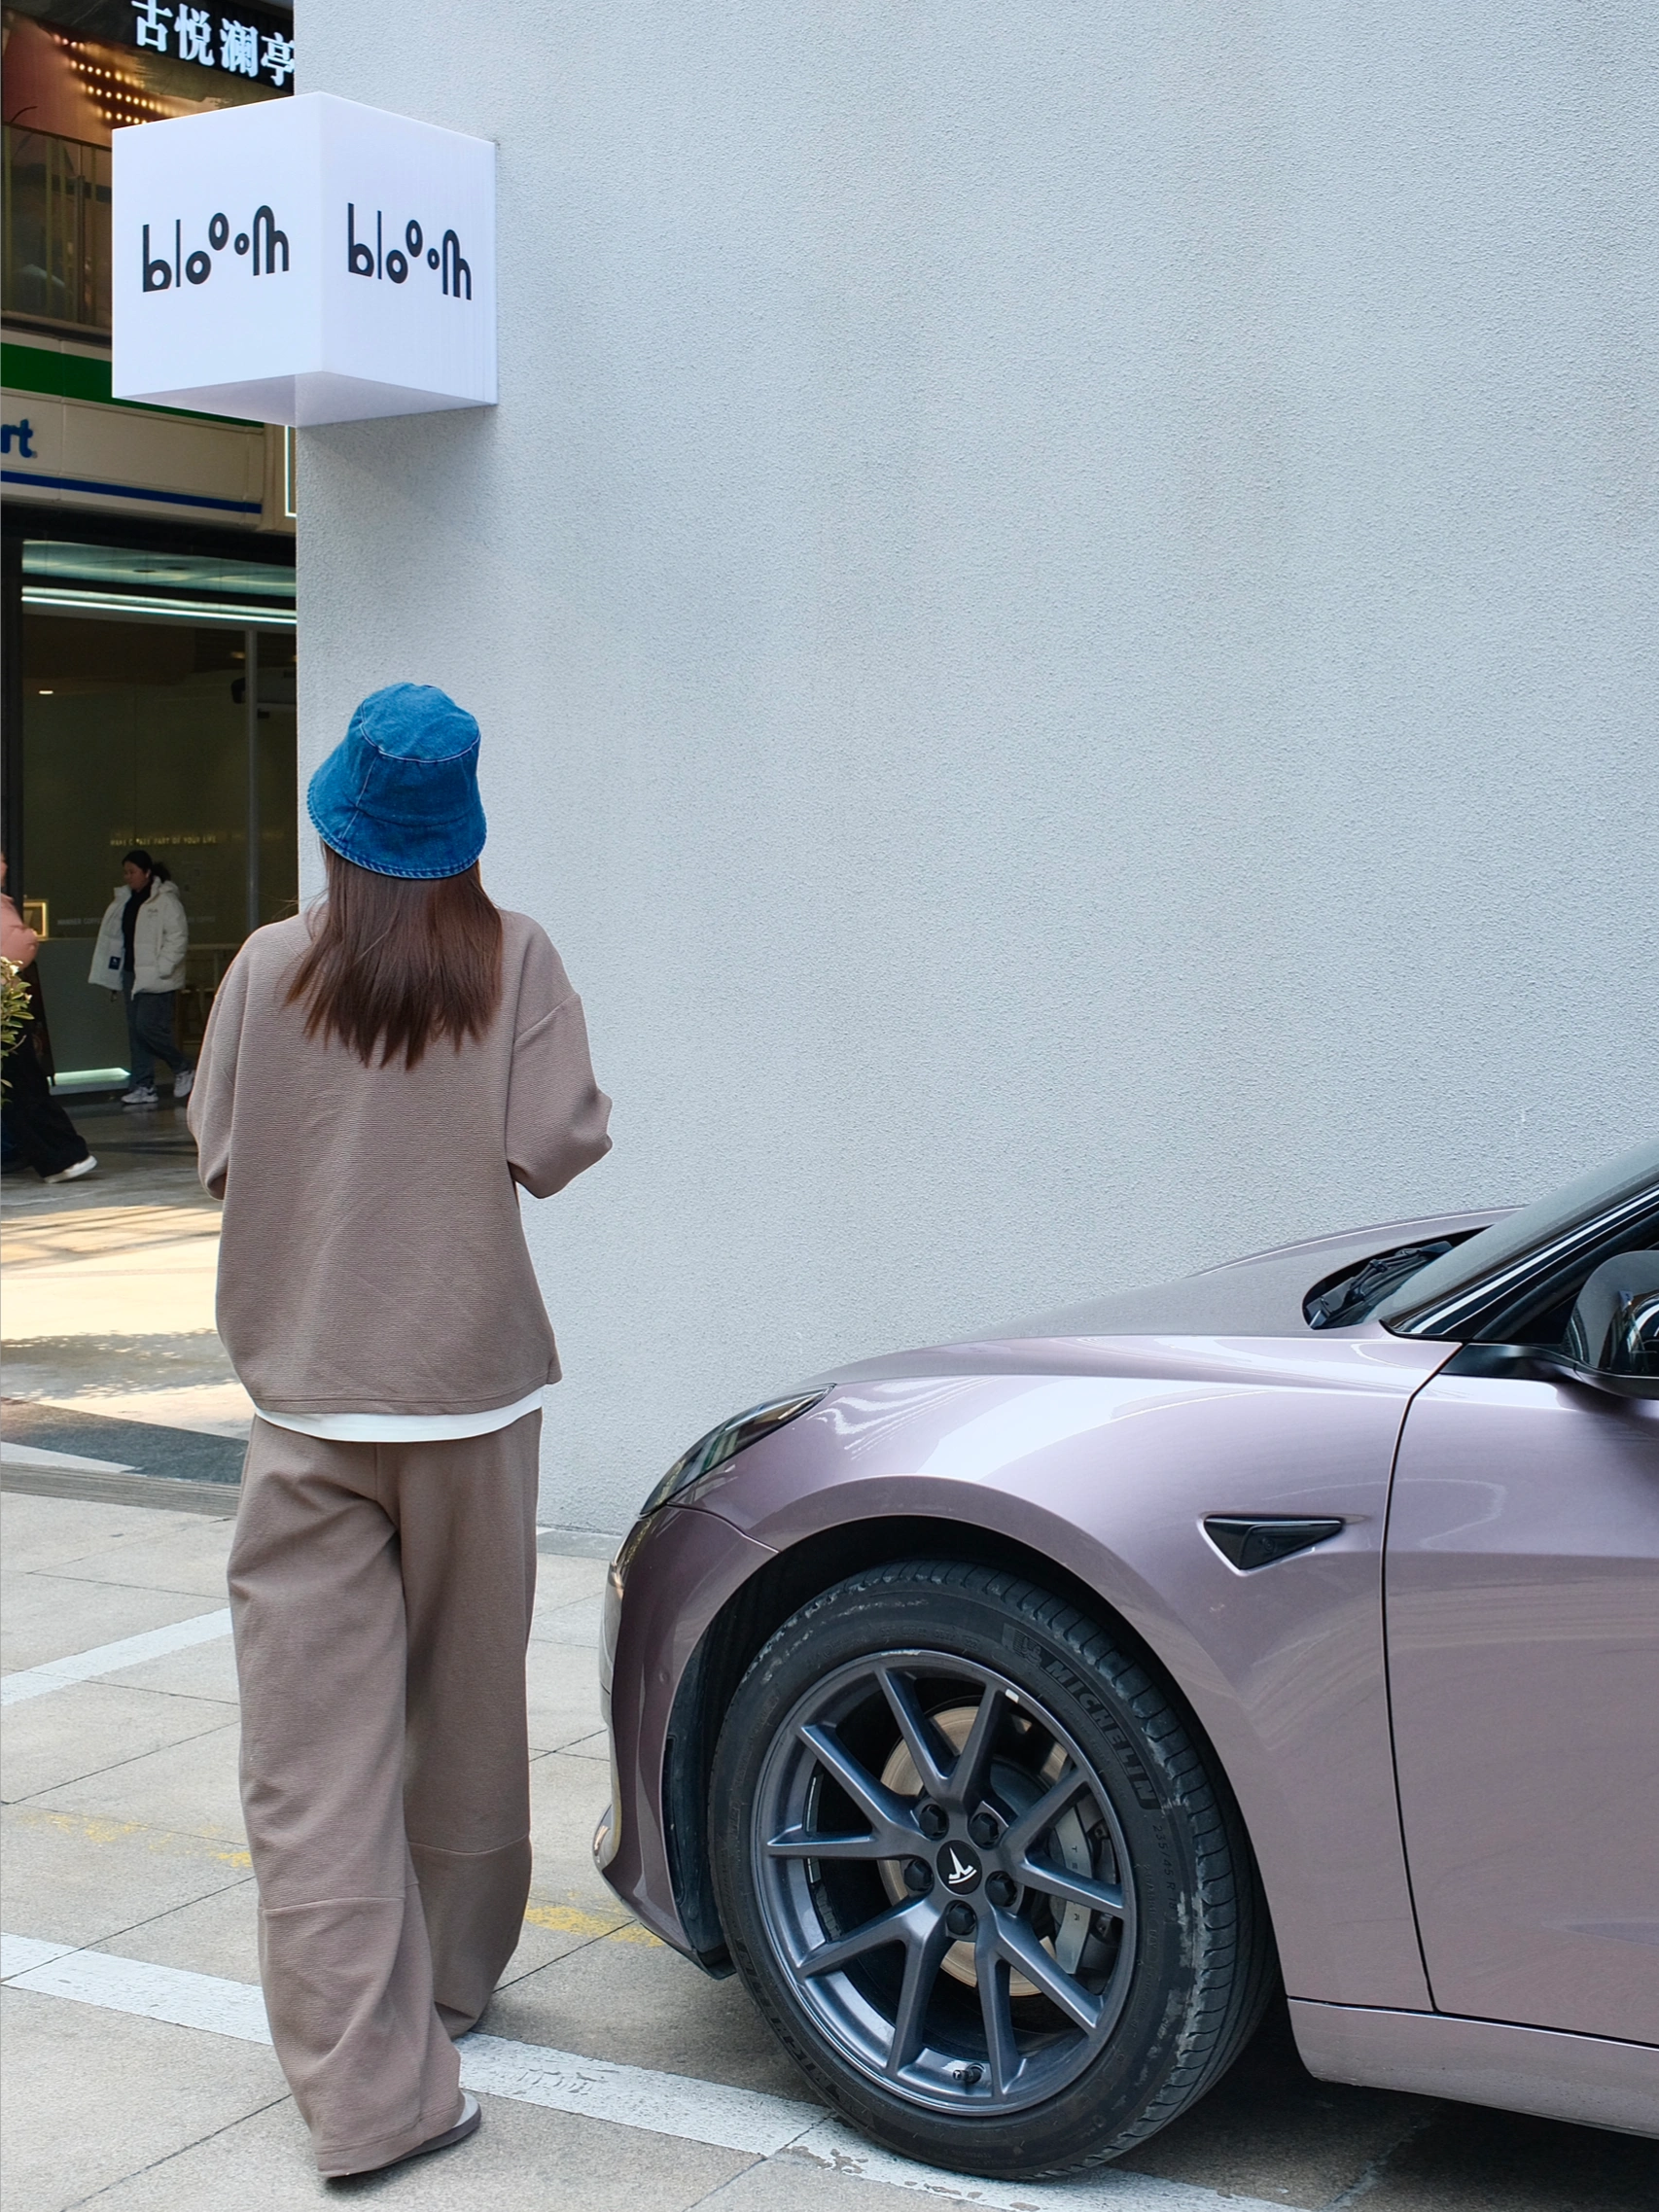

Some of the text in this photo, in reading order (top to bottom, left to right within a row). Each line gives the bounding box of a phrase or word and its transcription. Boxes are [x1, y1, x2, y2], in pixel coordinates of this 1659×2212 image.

[131, 0, 295, 87] 古悦澜亭
[1045, 1660, 1157, 1800] MICHELIN
[1152, 1824, 1175, 1877] 235/45
[1166, 1880, 1177, 1891] R
